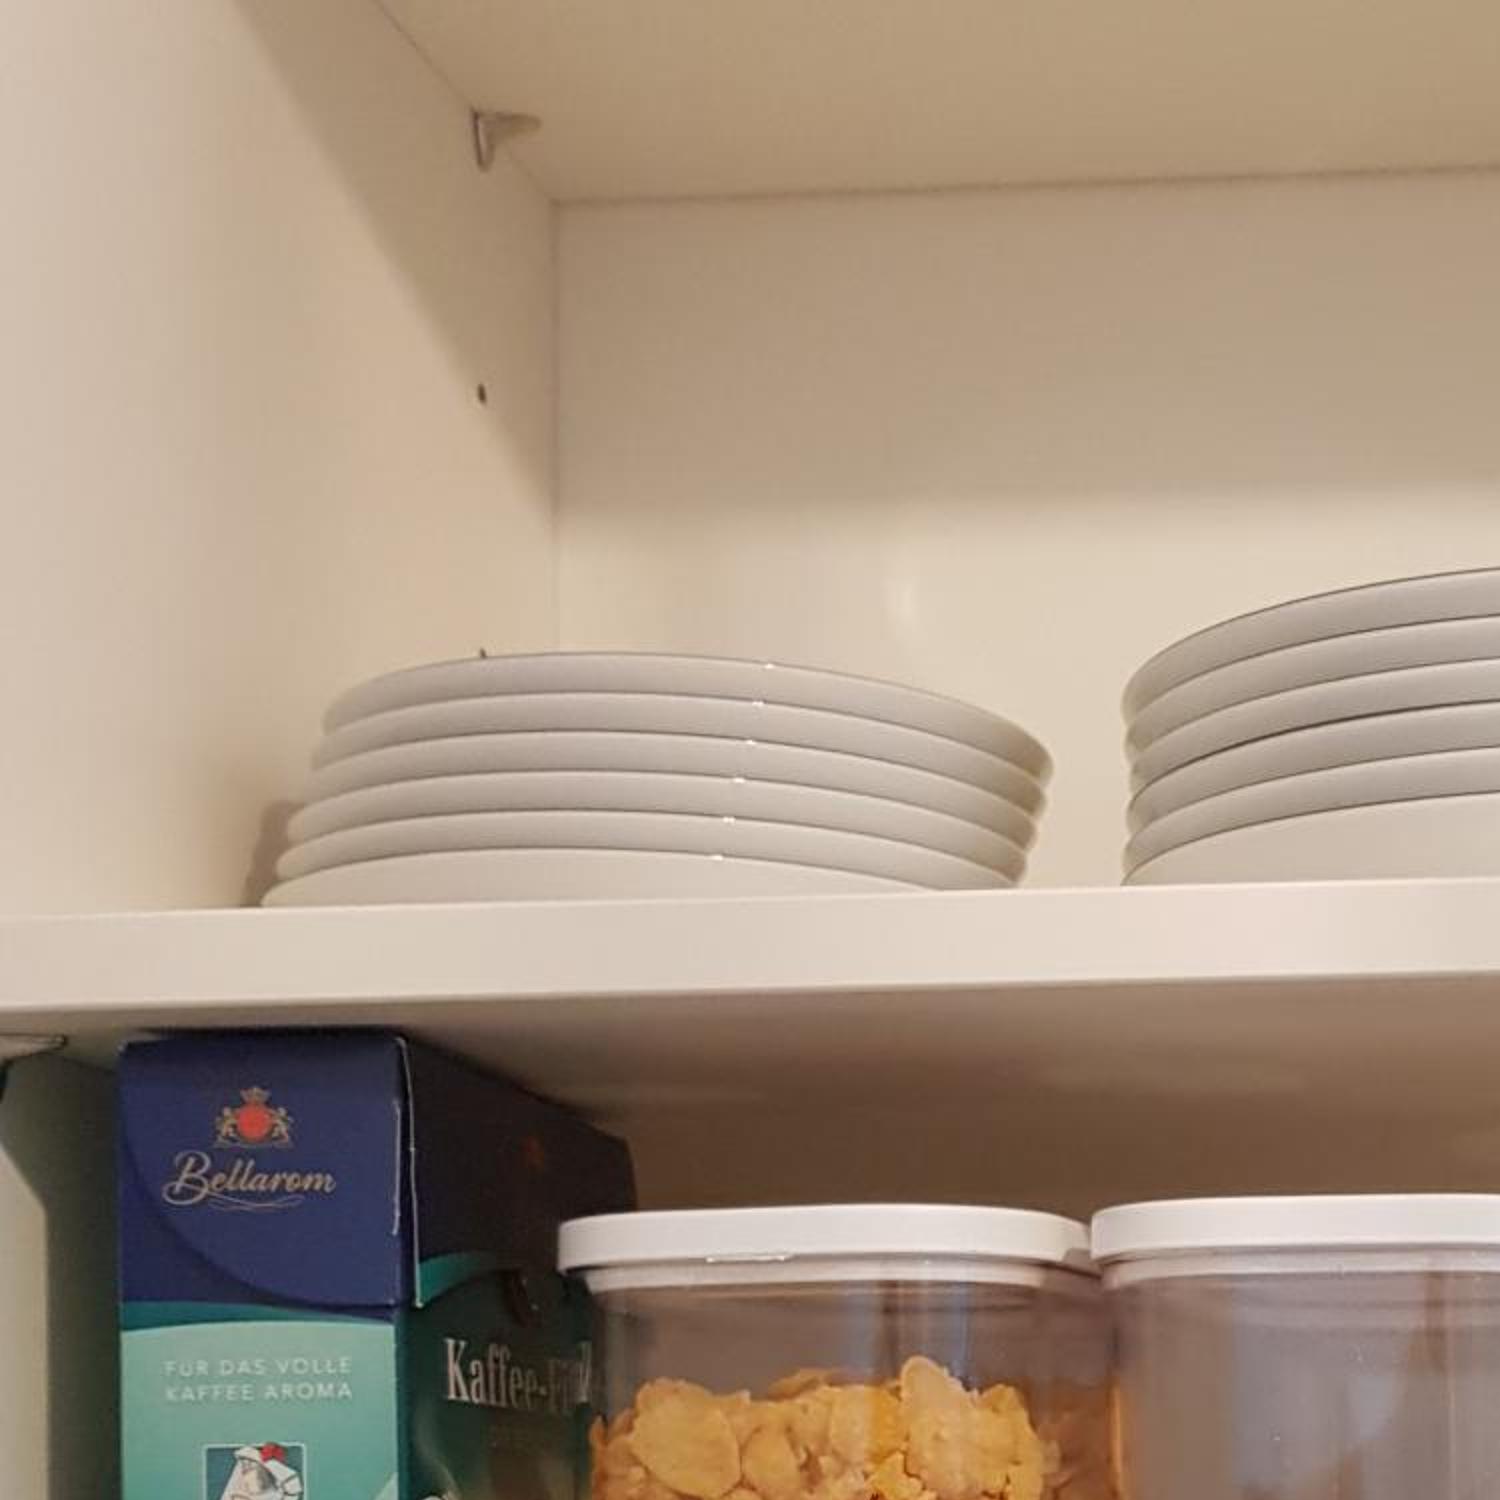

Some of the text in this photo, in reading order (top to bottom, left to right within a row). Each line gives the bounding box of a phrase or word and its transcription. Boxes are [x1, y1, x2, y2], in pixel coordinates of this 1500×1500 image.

[161, 1151, 337, 1206] Bellarom
[219, 1359, 267, 1376] DAS
[275, 1357, 352, 1375] VOLLE
[165, 1381, 352, 1402] KAFFEE AROMA
